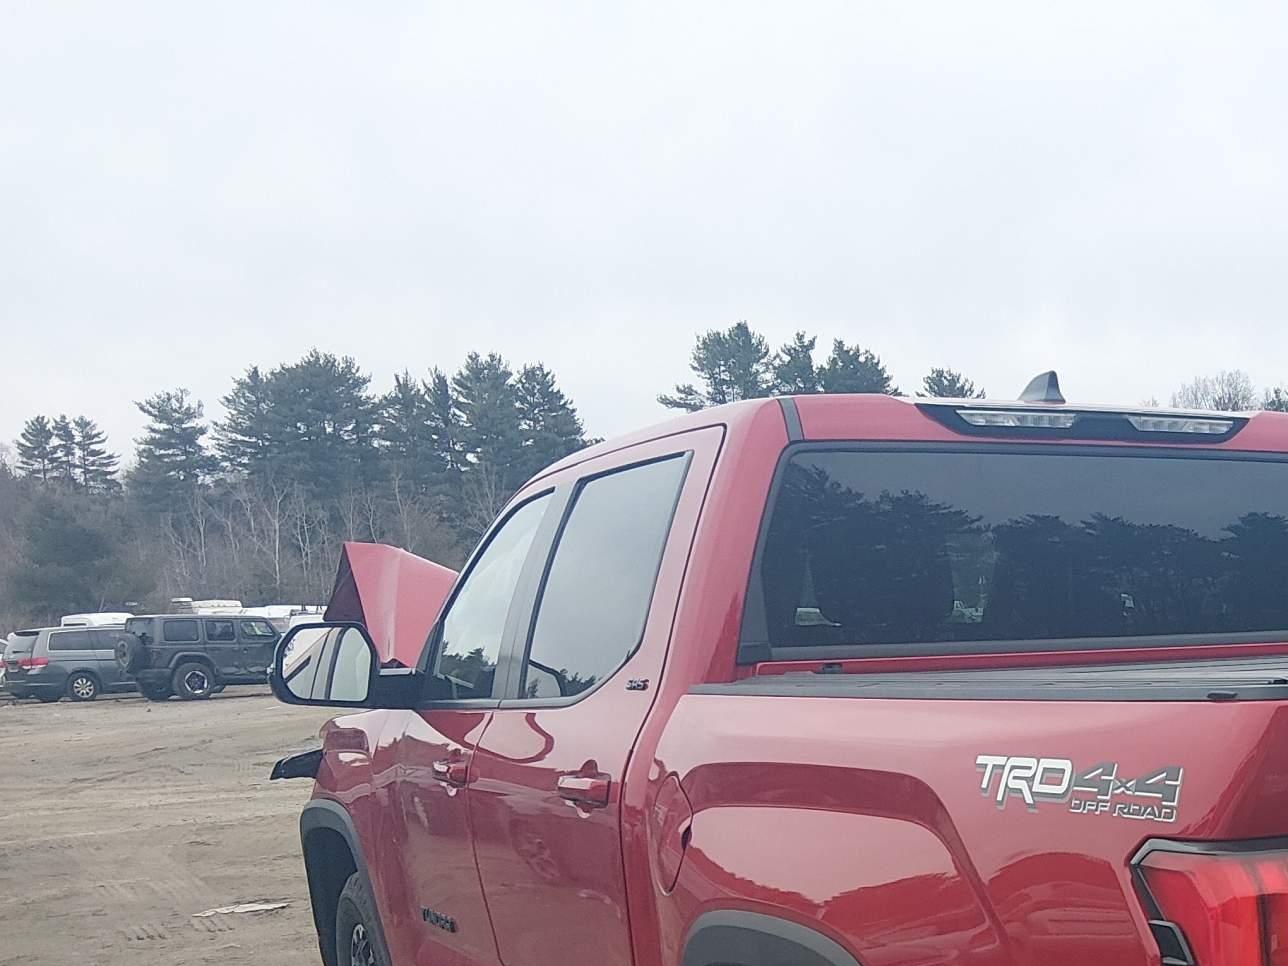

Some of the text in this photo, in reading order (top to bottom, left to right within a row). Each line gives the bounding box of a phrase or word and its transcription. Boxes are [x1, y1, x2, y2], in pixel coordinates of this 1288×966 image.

[975, 755, 1073, 808] TRD
[1069, 799, 1177, 822] OFF ROAD
